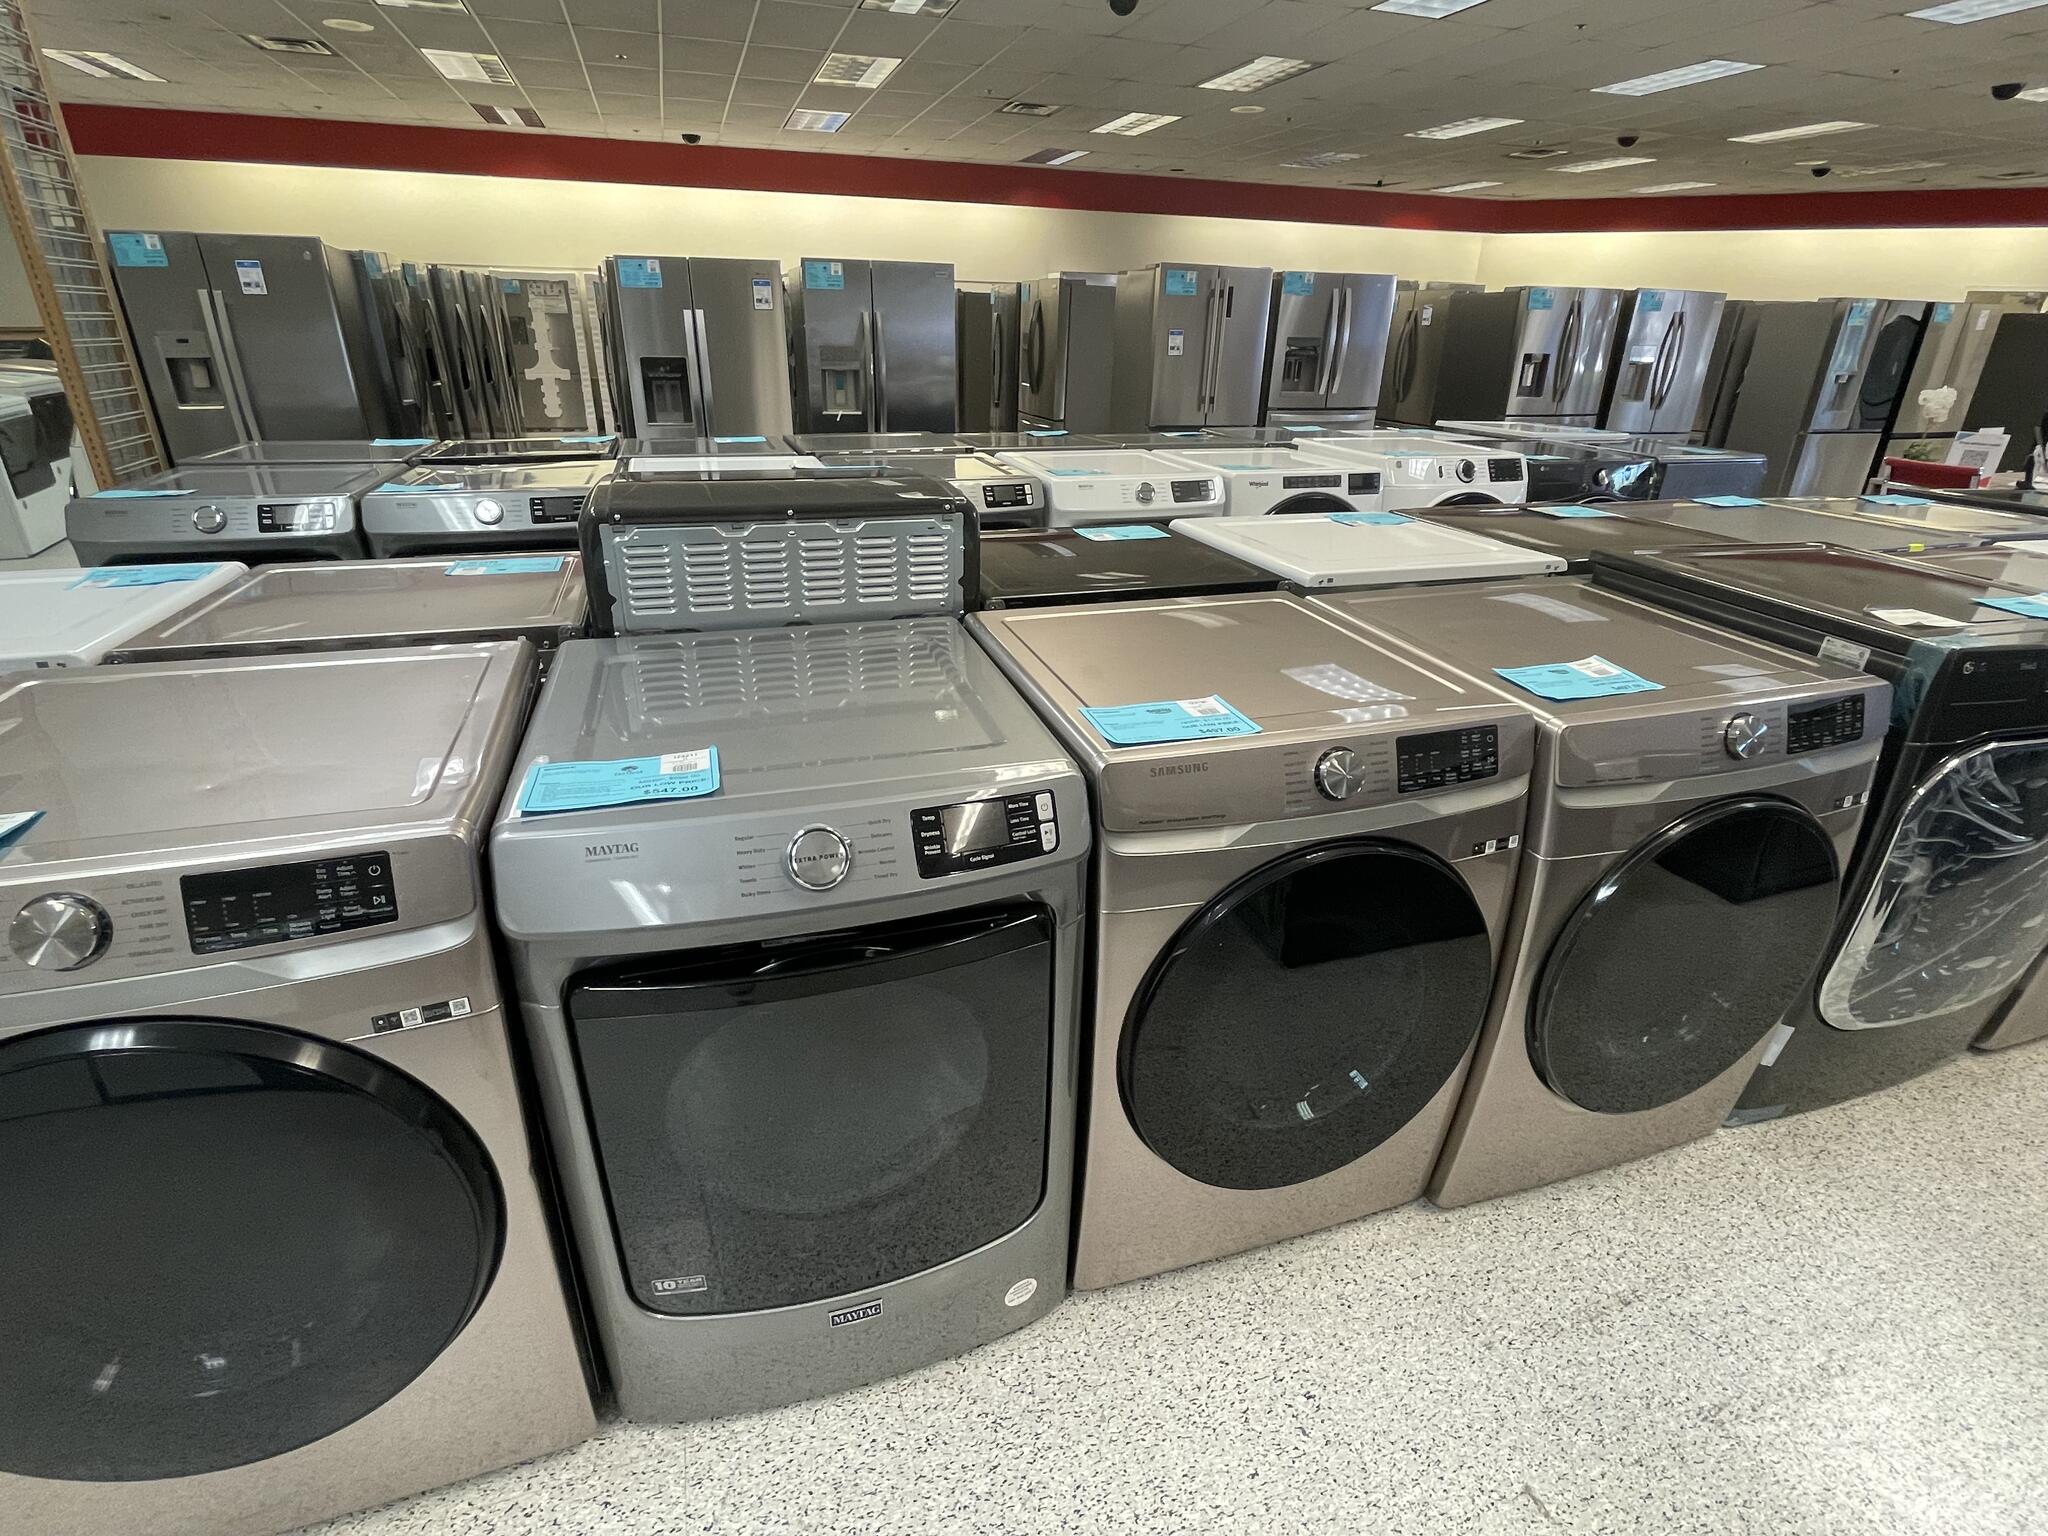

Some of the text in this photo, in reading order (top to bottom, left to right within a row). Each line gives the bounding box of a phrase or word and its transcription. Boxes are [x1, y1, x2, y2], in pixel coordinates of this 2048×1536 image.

[1150, 762, 1209, 778] SAMSUNG
[643, 785, 699, 795] $547.00
[920, 830, 941, 838] Dryness
[585, 842, 639, 857] MAYTAG
[655, 1281, 676, 1291] 10
[832, 1304, 881, 1325] MAYTAG
